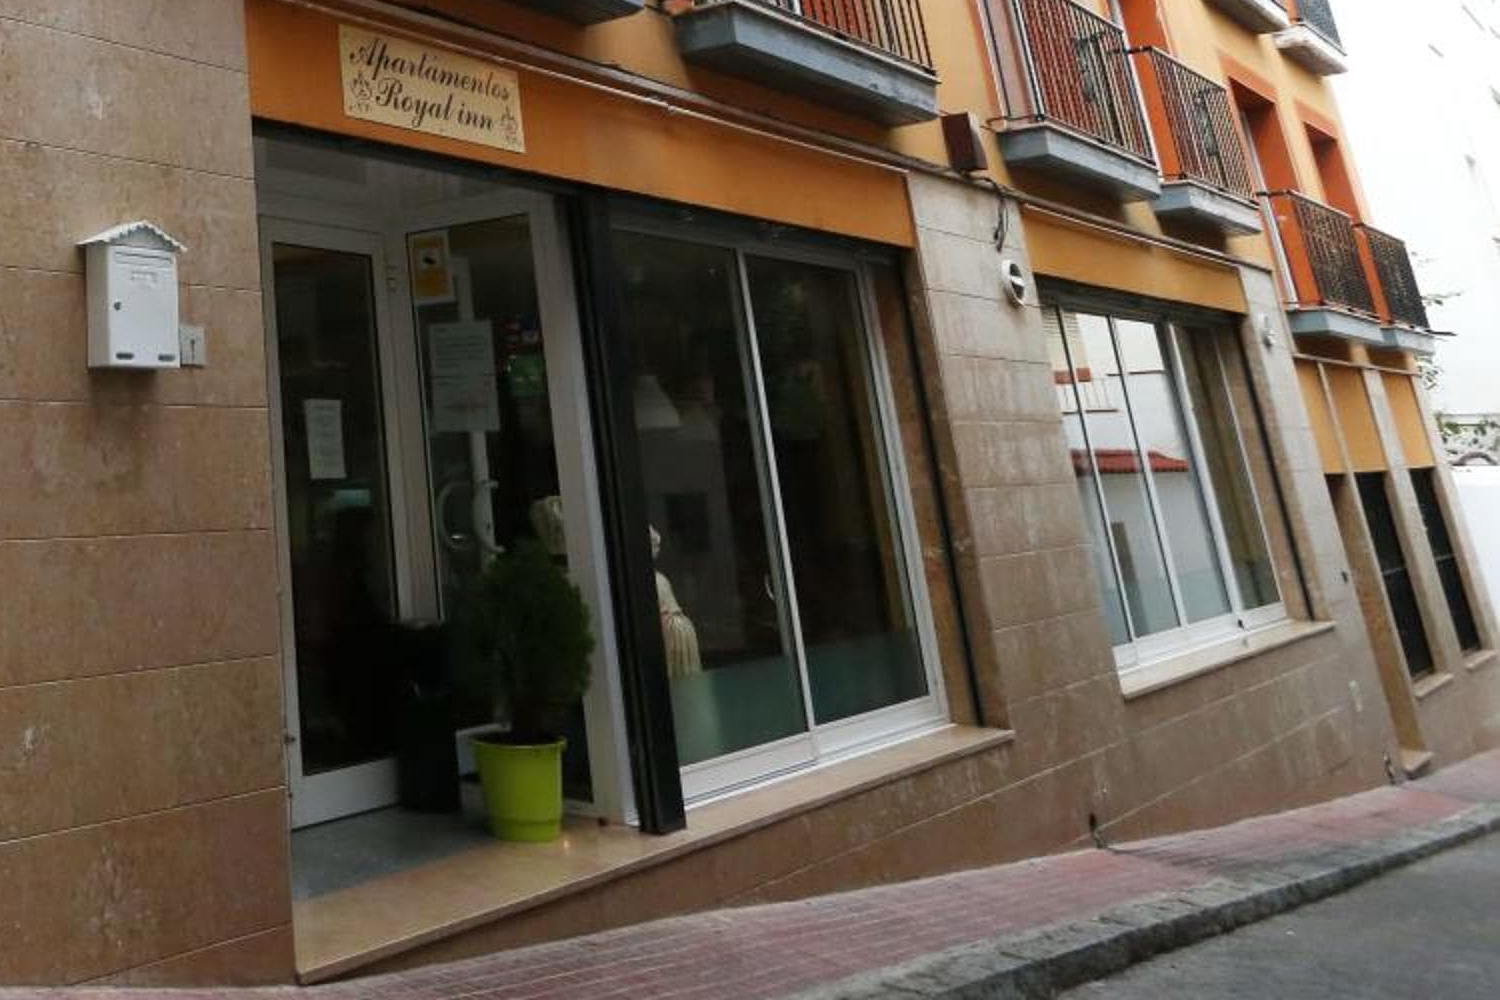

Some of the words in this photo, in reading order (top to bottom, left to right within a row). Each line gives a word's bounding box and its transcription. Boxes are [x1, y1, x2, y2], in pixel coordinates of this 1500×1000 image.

[350, 38, 509, 100] Apartamentos
[376, 78, 454, 127] Royal
[459, 104, 492, 130] inn
